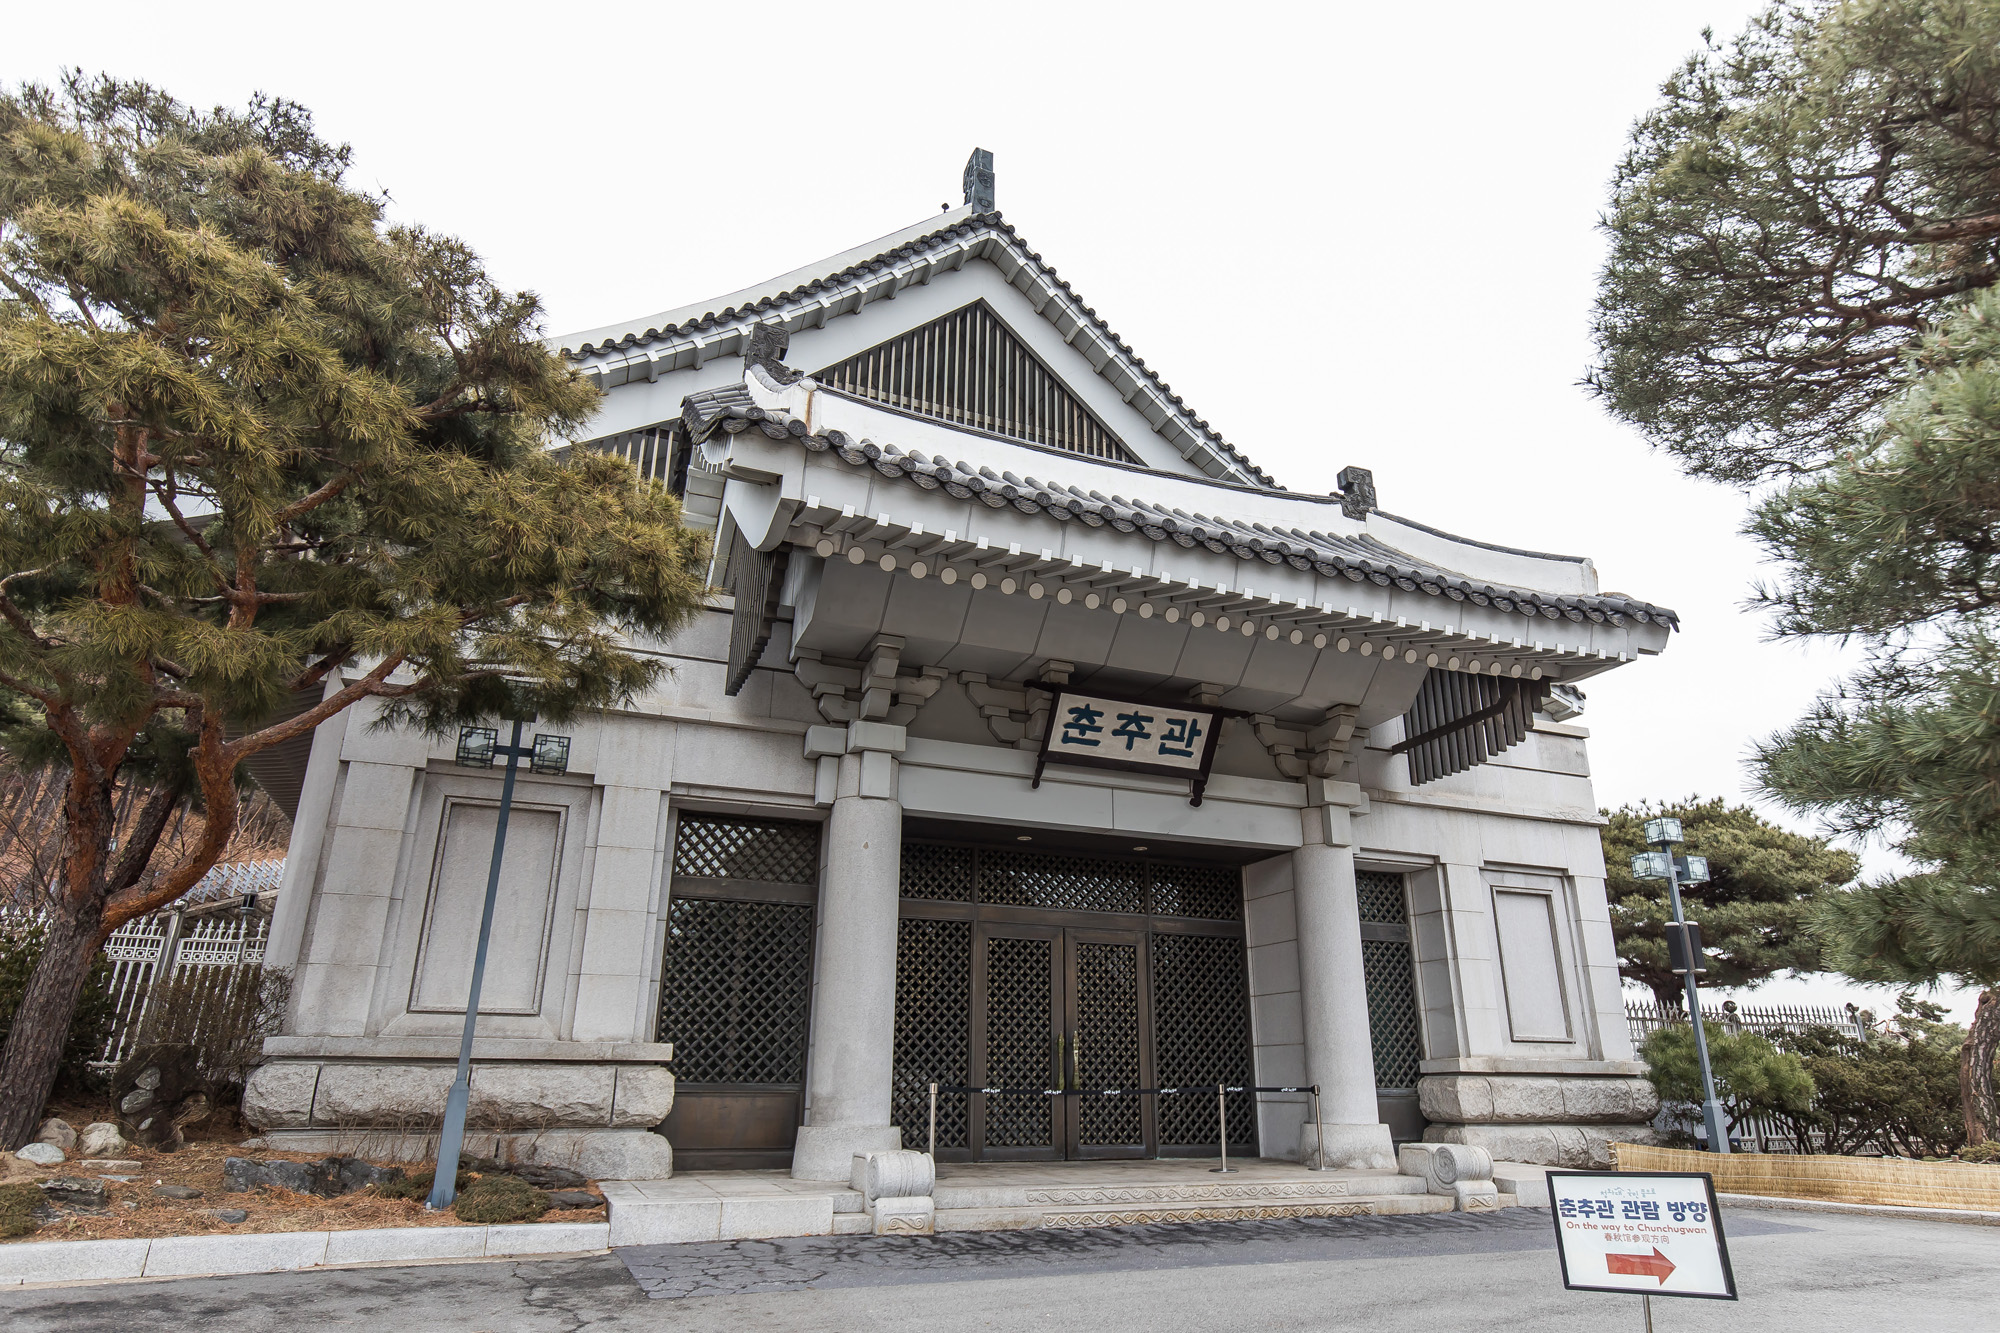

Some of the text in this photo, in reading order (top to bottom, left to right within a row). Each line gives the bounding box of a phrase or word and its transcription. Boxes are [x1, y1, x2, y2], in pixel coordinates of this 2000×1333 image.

[1061, 703, 1202, 758] 춘추관
[1559, 1198, 1708, 1222] 춘추관 관람 방향
[1566, 1221, 1707, 1235] On the way to Chunchugwan
[1604, 1232, 1670, 1244] 春秋馆参观方向
